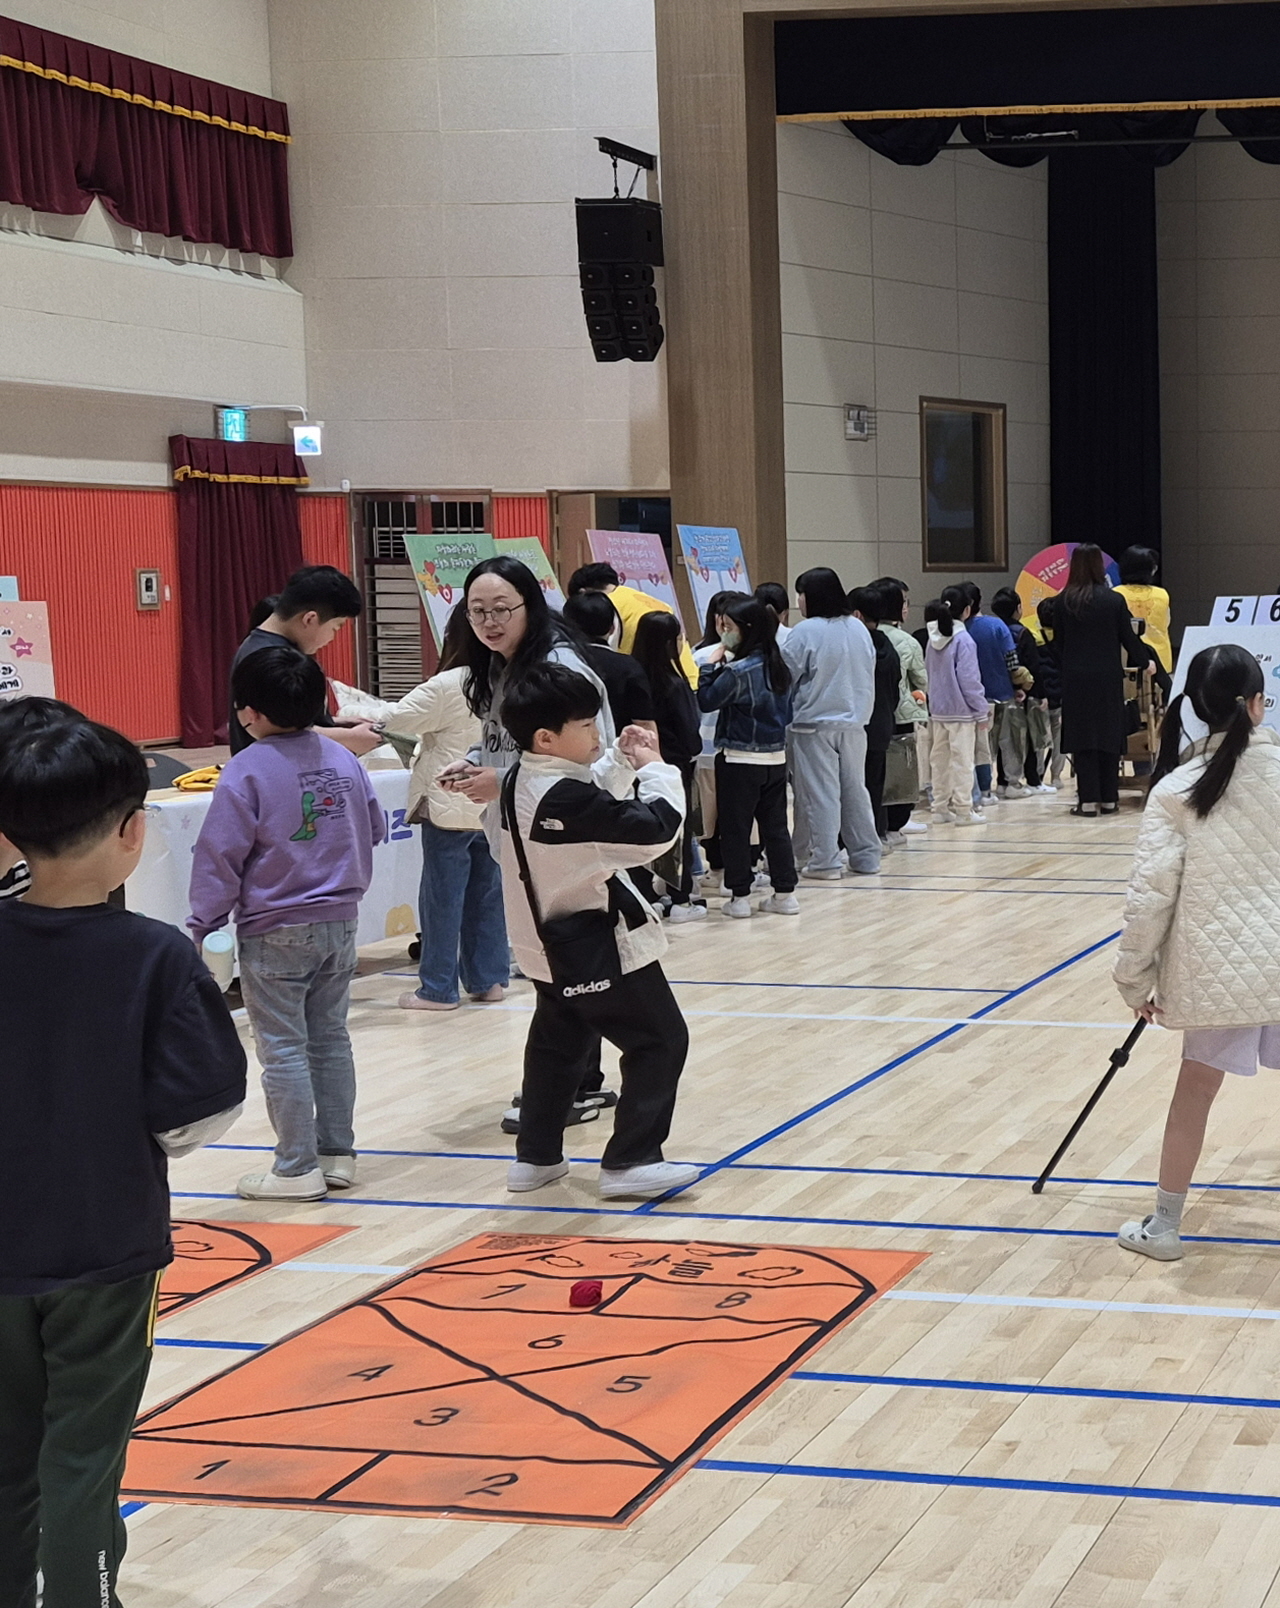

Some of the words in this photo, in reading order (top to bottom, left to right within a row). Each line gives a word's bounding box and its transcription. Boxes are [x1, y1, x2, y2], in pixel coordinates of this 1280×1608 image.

[1225, 598, 1243, 623] 5
[563, 979, 611, 997] adidas
[715, 1292, 751, 1308] 8
[528, 1334, 566, 1350] 6
[348, 1364, 394, 1382] 4
[606, 1375, 651, 1393] 5
[413, 1407, 460, 1427] 3
[194, 1459, 231, 1480] 1
[465, 1472, 519, 1496] 2
[98, 1549, 107, 1570] new
